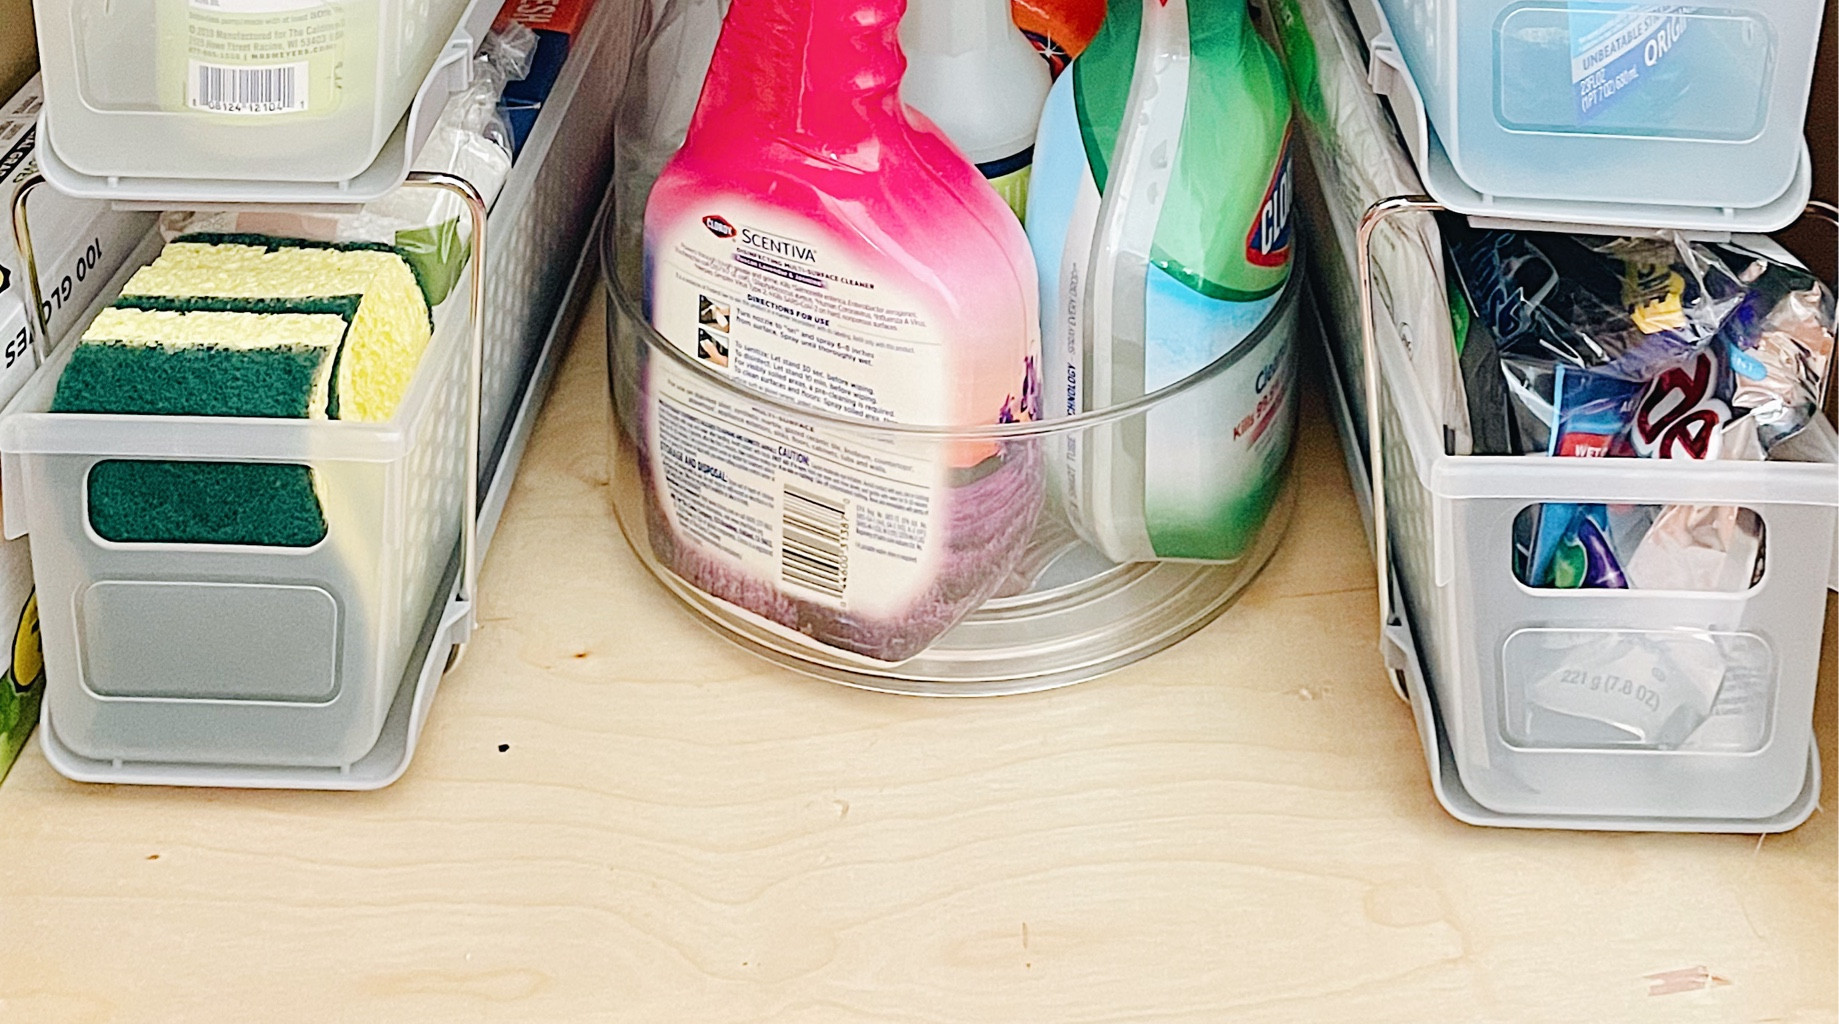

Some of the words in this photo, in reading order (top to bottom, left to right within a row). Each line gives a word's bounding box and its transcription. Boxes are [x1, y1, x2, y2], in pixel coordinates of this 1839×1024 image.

[76, 237, 102, 282] 100
[742, 229, 816, 263] SCENTIVA
[841, 277, 874, 289] CLEANER
[5, 275, 72, 369] GLOES
[737, 308, 750, 317] Turn
[752, 314, 773, 326] nozzle
[775, 321, 782, 329] to
[801, 332, 815, 341] and
[816, 337, 835, 348] spray
[852, 347, 875, 358] inches
[747, 294, 795, 316] DIRECTIONS
[796, 311, 812, 321] FOR
[814, 317, 830, 327] USE
[736, 316, 751, 327] from
[780, 332, 799, 344] Spray
[818, 345, 856, 362] thoroughly
[735, 340, 743, 349] To
[771, 354, 781, 362] Let
[783, 358, 800, 370] stand
[802, 365, 811, 373] 30
[827, 373, 849, 386] before
[735, 348, 743, 357] To
[773, 363, 784, 372] Let
[785, 368, 803, 379] stand
[830, 383, 851, 396] before
[734, 365, 742, 374] To
[743, 369, 760, 381] clean
[761, 376, 786, 390] surfaces
[788, 385, 800, 395] and
[823, 397, 842, 411] Spray
[844, 405, 864, 417] soiled
[735, 357, 745, 367] For
[746, 363, 766, 375] visibly
[768, 369, 787, 382] soiled
[815, 386, 856, 408] pre-cleaning
[865, 403, 895, 417] required.
[1067, 362, 1076, 416] CHNOLOGY
[684, 455, 697, 469] AND
[856, 458, 868, 467] and
[1560, 670, 1588, 685] 221
[1590, 676, 1601, 691] g
[1603, 677, 1632, 696] (7.8
[1635, 685, 1660, 712] OZ)
